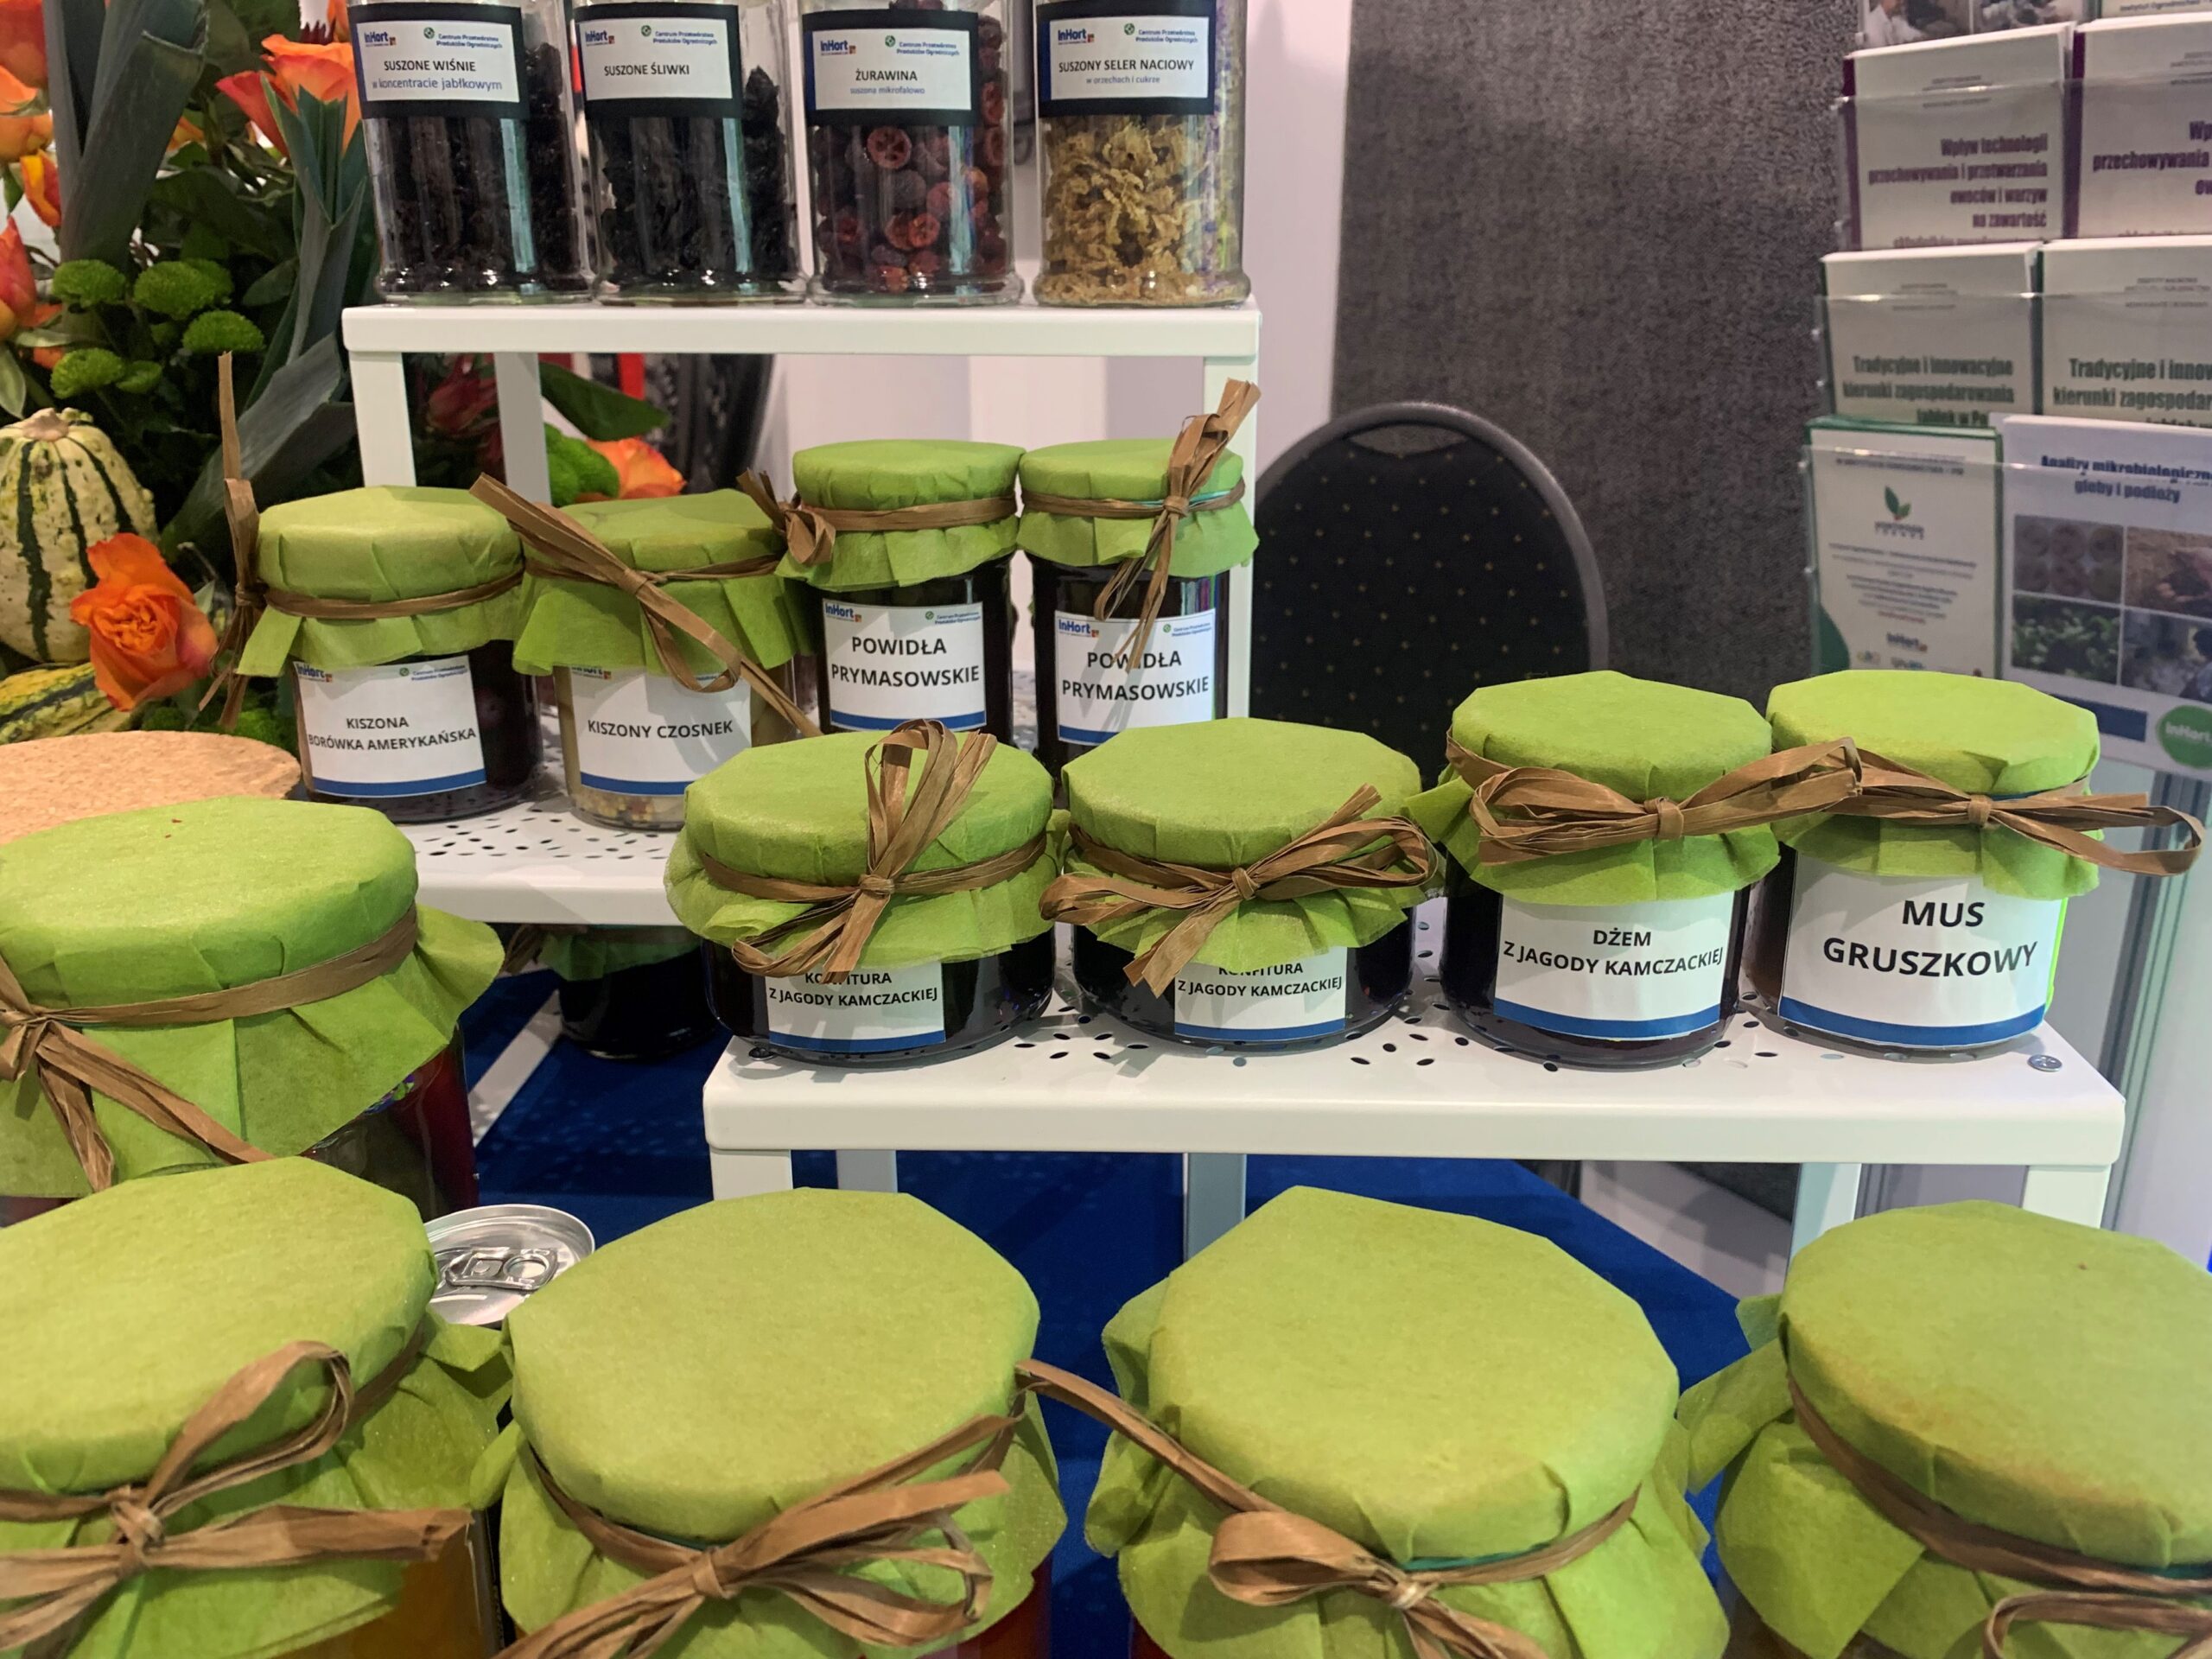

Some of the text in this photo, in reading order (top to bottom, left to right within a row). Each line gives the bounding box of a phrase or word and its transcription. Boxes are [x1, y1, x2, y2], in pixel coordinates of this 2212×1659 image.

[364, 32, 388, 42] InHort
[1058, 29, 1086, 41] InHort
[820, 40, 849, 52] InHort
[384, 58, 476, 72] SUSZONE WIŚNIE
[604, 62, 690, 76] SUSZONE ŚLIWKI
[1058, 60, 1194, 73] SUSZONY SELER NACIOWY
[855, 68, 918, 81] ŻURAWINA
[378, 79, 438, 89] koncentracie
[442, 78, 503, 92] jabłkowym
[879, 86, 925, 94] mikrofalowo
[2093, 149, 2209, 172] przechowywania
[2069, 358, 2157, 381] Tradycyjne
[2053, 385, 2116, 407] kierunki
[2092, 460, 2212, 484] mikrobiologiczn
[824, 603, 854, 619] InHort
[1058, 619, 1090, 634] InHort
[852, 637, 947, 655] POWIDŁA
[1087, 651, 1182, 670] POWDŁA
[831, 664, 980, 687] PRYMASOWSKIE
[1062, 676, 1209, 702] PRYMASOWSKIE
[346, 716, 410, 729] KISZONA
[588, 720, 734, 738] KISZONY CZOSNEK
[308, 727, 477, 751] BORÓWKA AMERYKAŃSKA
[1903, 899, 1986, 927] MUS
[1592, 927, 1651, 946] DŻEM
[1503, 940, 1724, 976] Z JAGODY KAMCZACKIEJ
[1823, 937, 2038, 977] GRUSZKOWY
[805, 972, 893, 985] KOITURA
[1178, 976, 1342, 996] Z JAGODY KAMCZACKIEJ
[769, 987, 938, 1007] Z JAGODY KAMCZACKIEJ
